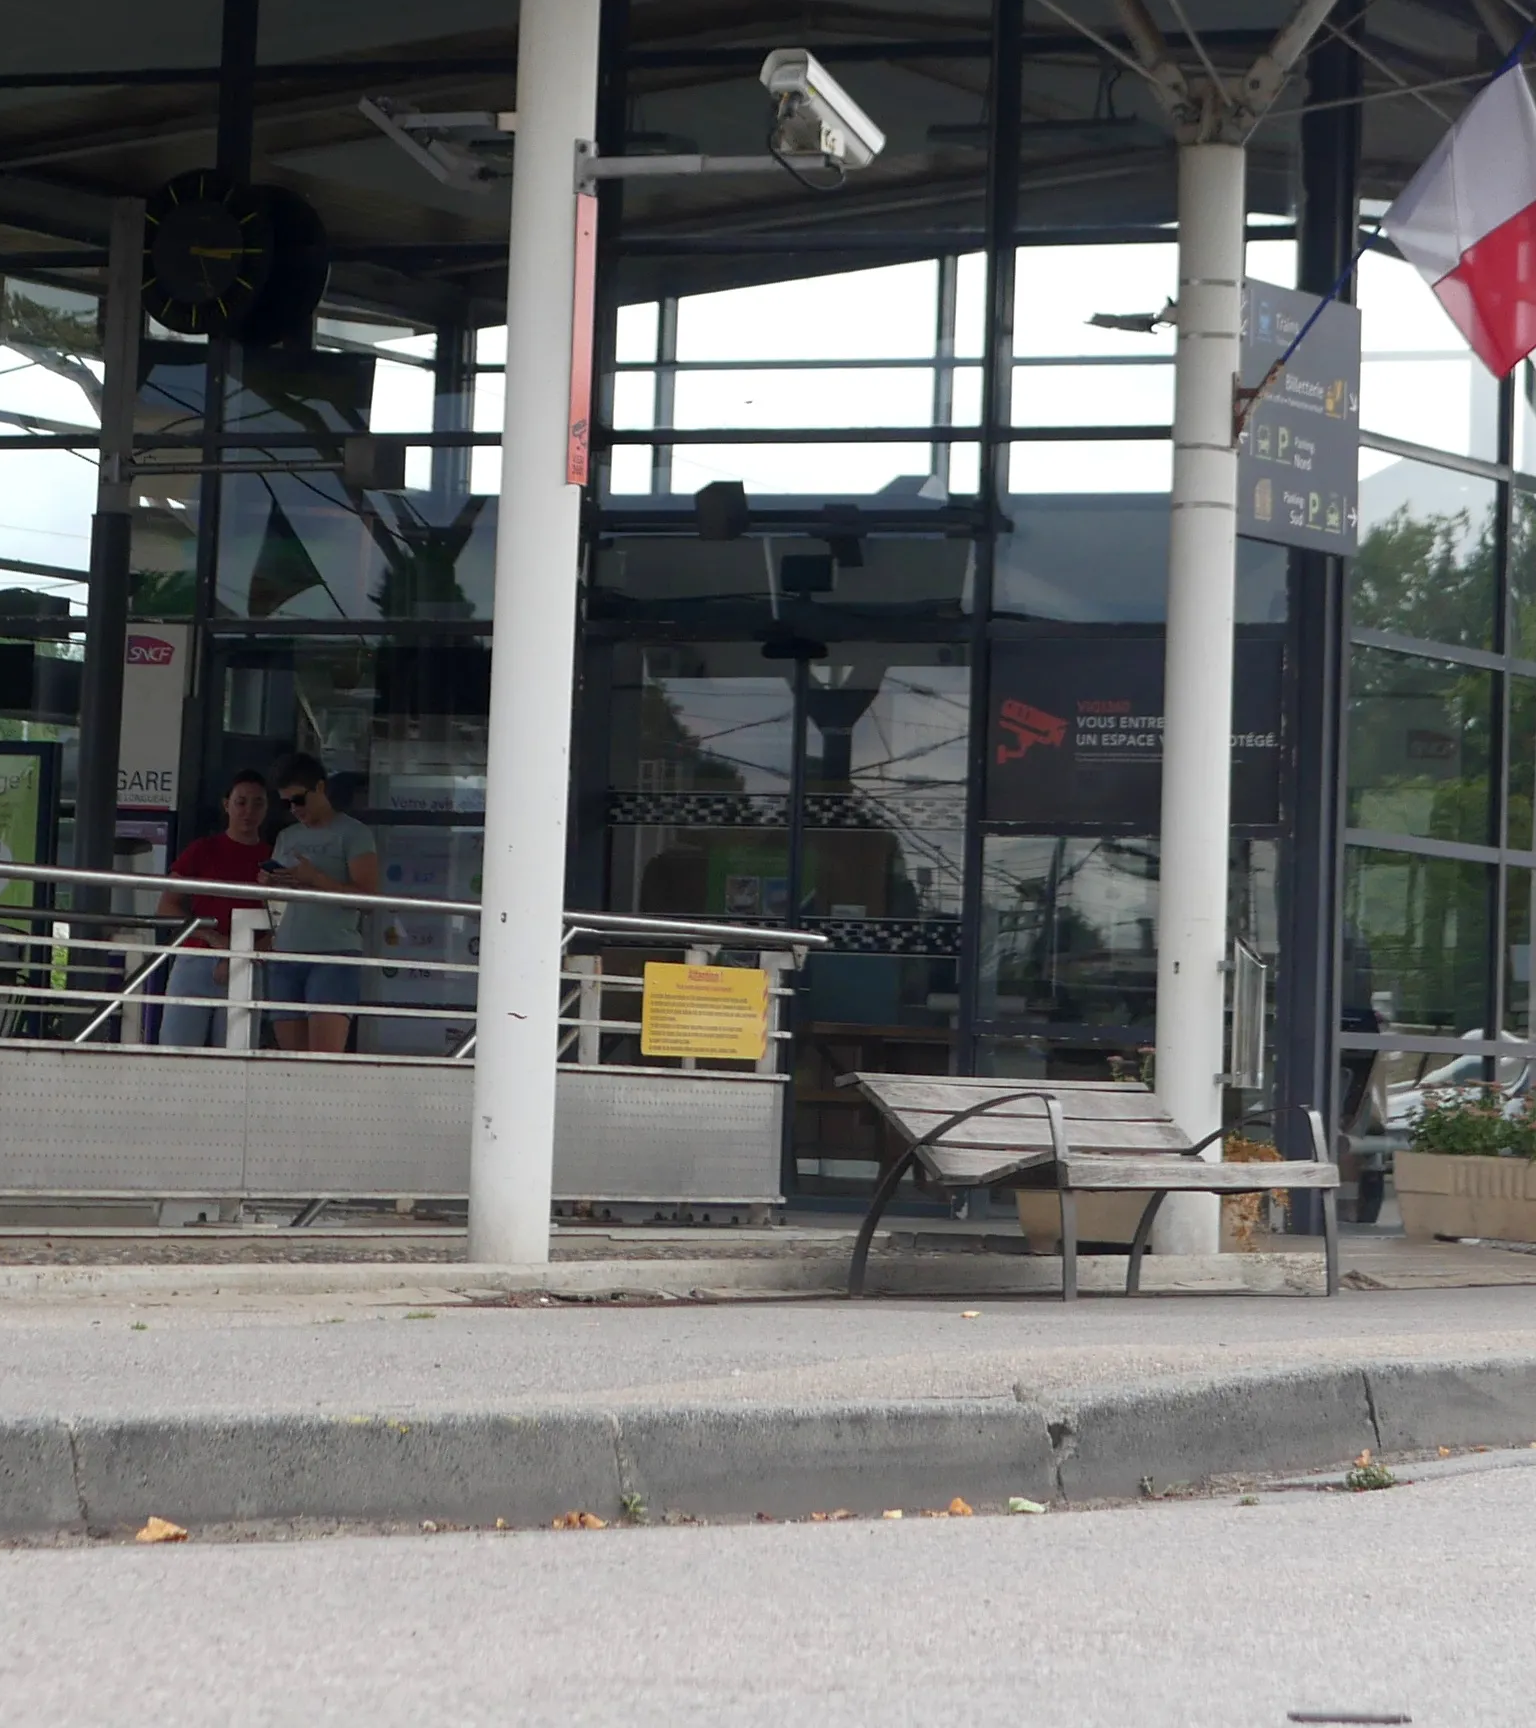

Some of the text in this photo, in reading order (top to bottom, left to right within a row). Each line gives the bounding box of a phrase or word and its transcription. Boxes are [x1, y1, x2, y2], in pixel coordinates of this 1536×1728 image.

[1293, 453, 1312, 471] Nord
[1290, 509, 1304, 527] Sud
[127, 645, 172, 662] SNCF
[1076, 715, 1165, 729] VOUS ENTRE
[1076, 733, 1098, 746] UN
[1101, 733, 1156, 747] ESPACE
